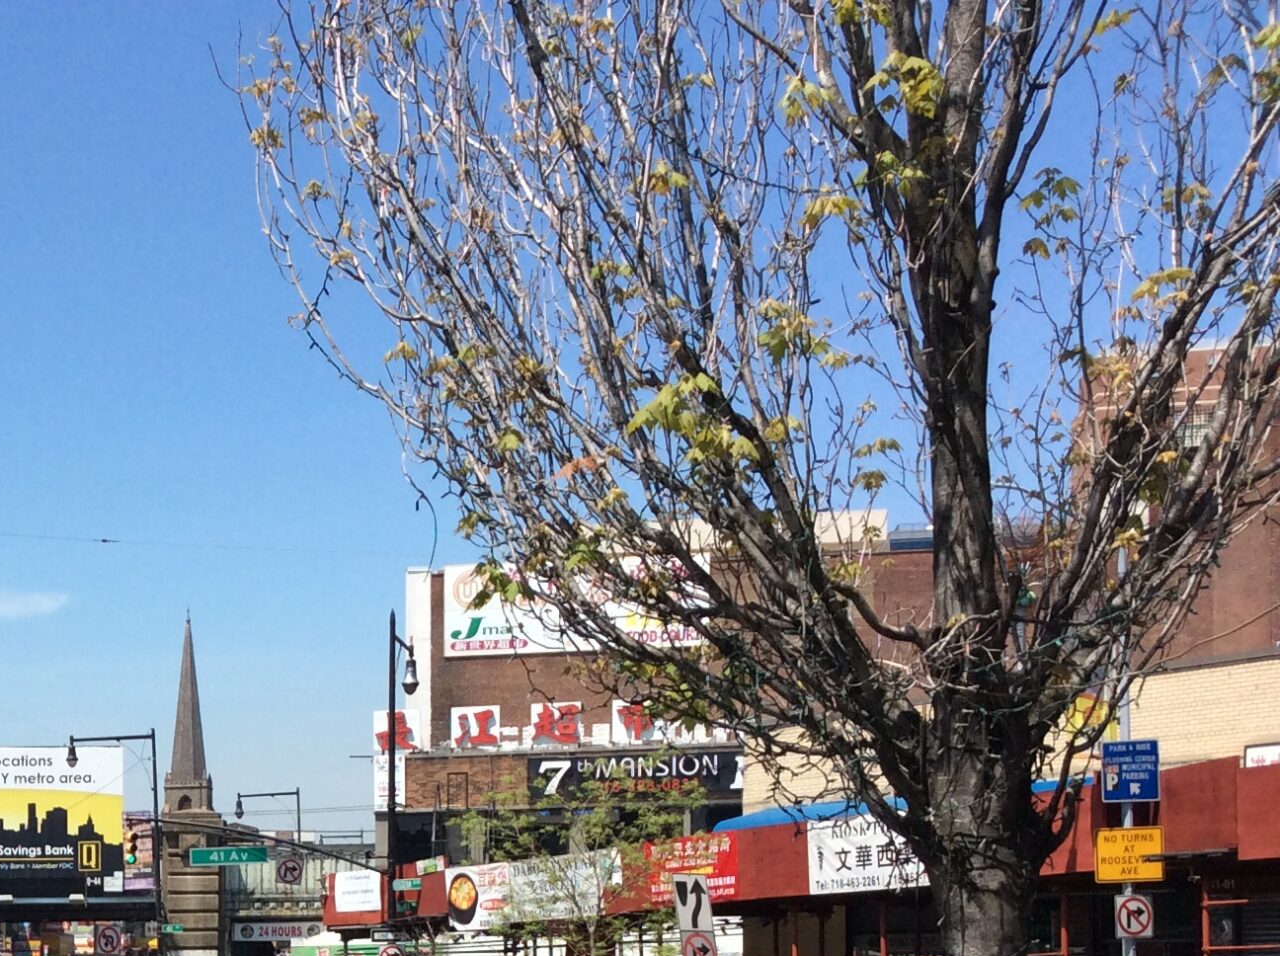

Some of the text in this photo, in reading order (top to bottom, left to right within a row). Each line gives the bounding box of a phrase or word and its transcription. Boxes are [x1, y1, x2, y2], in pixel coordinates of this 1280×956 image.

[14, 773, 55, 784] metro
[59, 774, 96, 784] area.
[1106, 773, 1119, 791] P
[1103, 833, 1154, 843] NO TURNS
[45, 844, 74, 856] Bank
[1123, 845, 1135, 853] AT
[209, 851, 249, 861] 41 Av
[1100, 857, 1148, 866] ROOSEV
[1120, 867, 1139, 876] AVE
[258, 925, 303, 937] 24 HOURS
